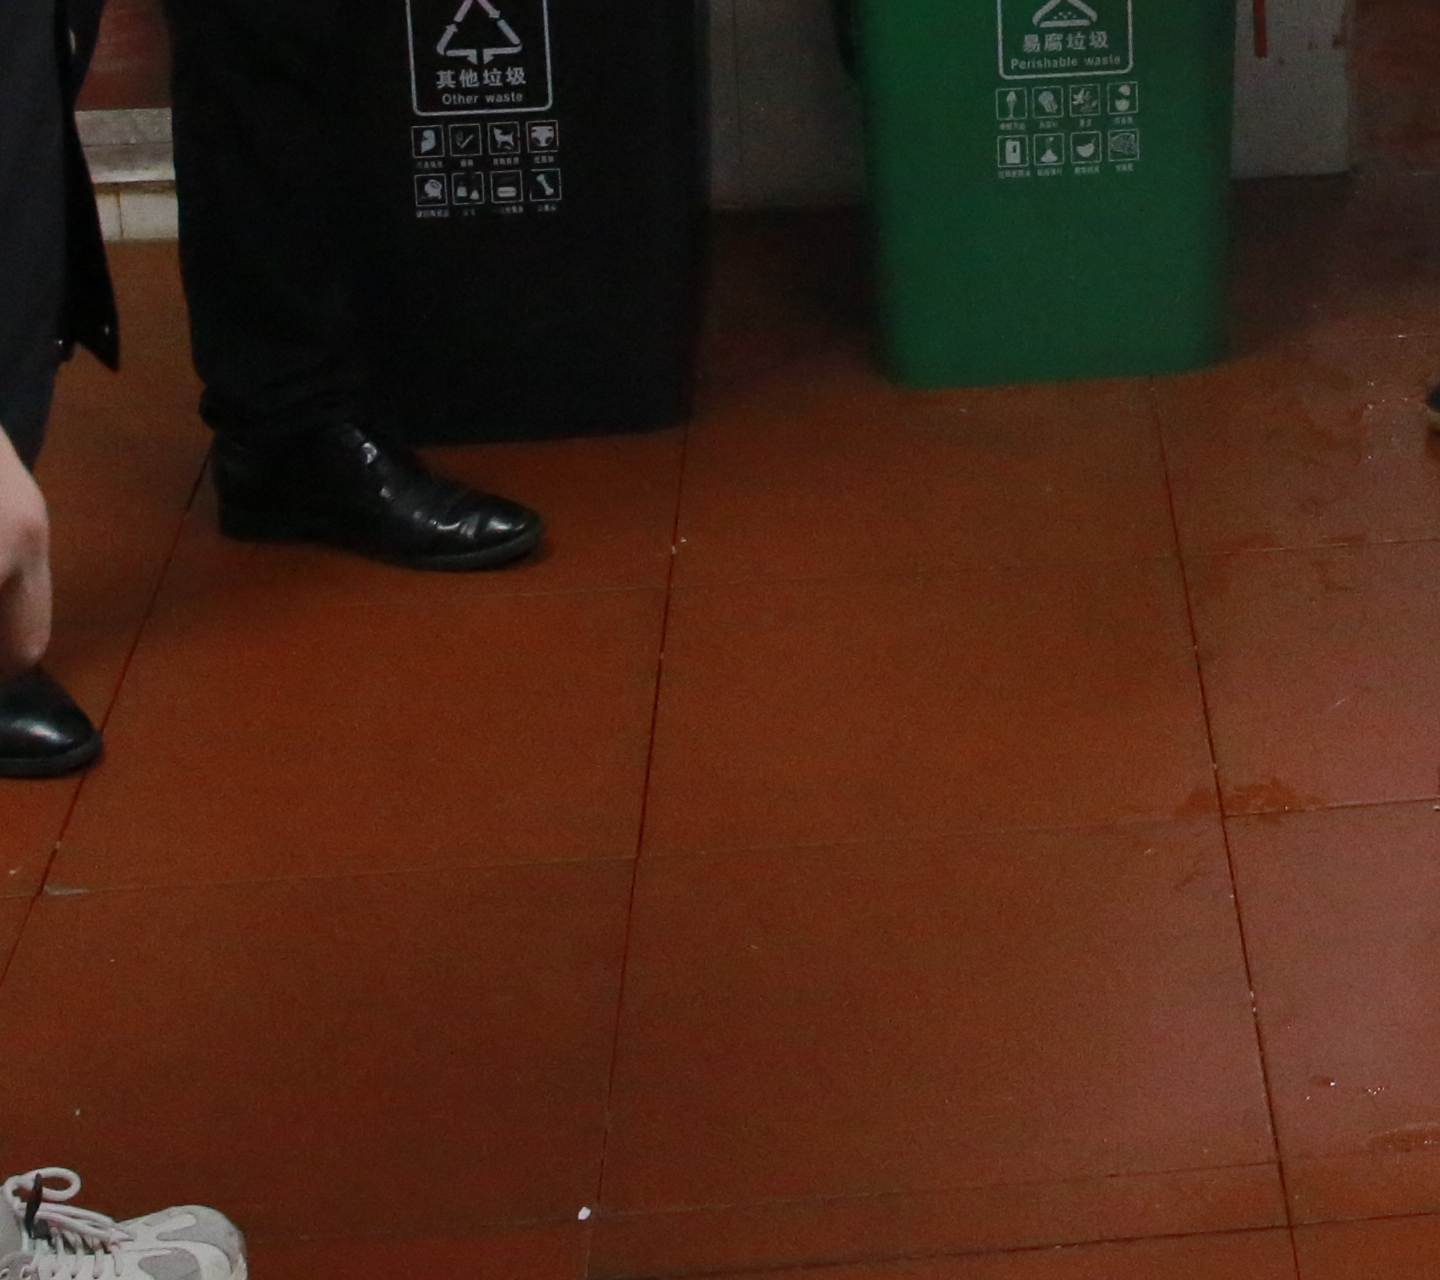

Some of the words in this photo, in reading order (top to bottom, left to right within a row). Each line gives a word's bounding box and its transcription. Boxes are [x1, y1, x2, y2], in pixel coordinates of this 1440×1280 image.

[1022, 31, 1109, 54] 易腐垃圾
[1010, 57, 1078, 70] Perishable
[1084, 54, 1121, 66] waste
[436, 66, 527, 89] 其他垃圾
[441, 93, 479, 105] Other
[485, 92, 523, 103] waste
